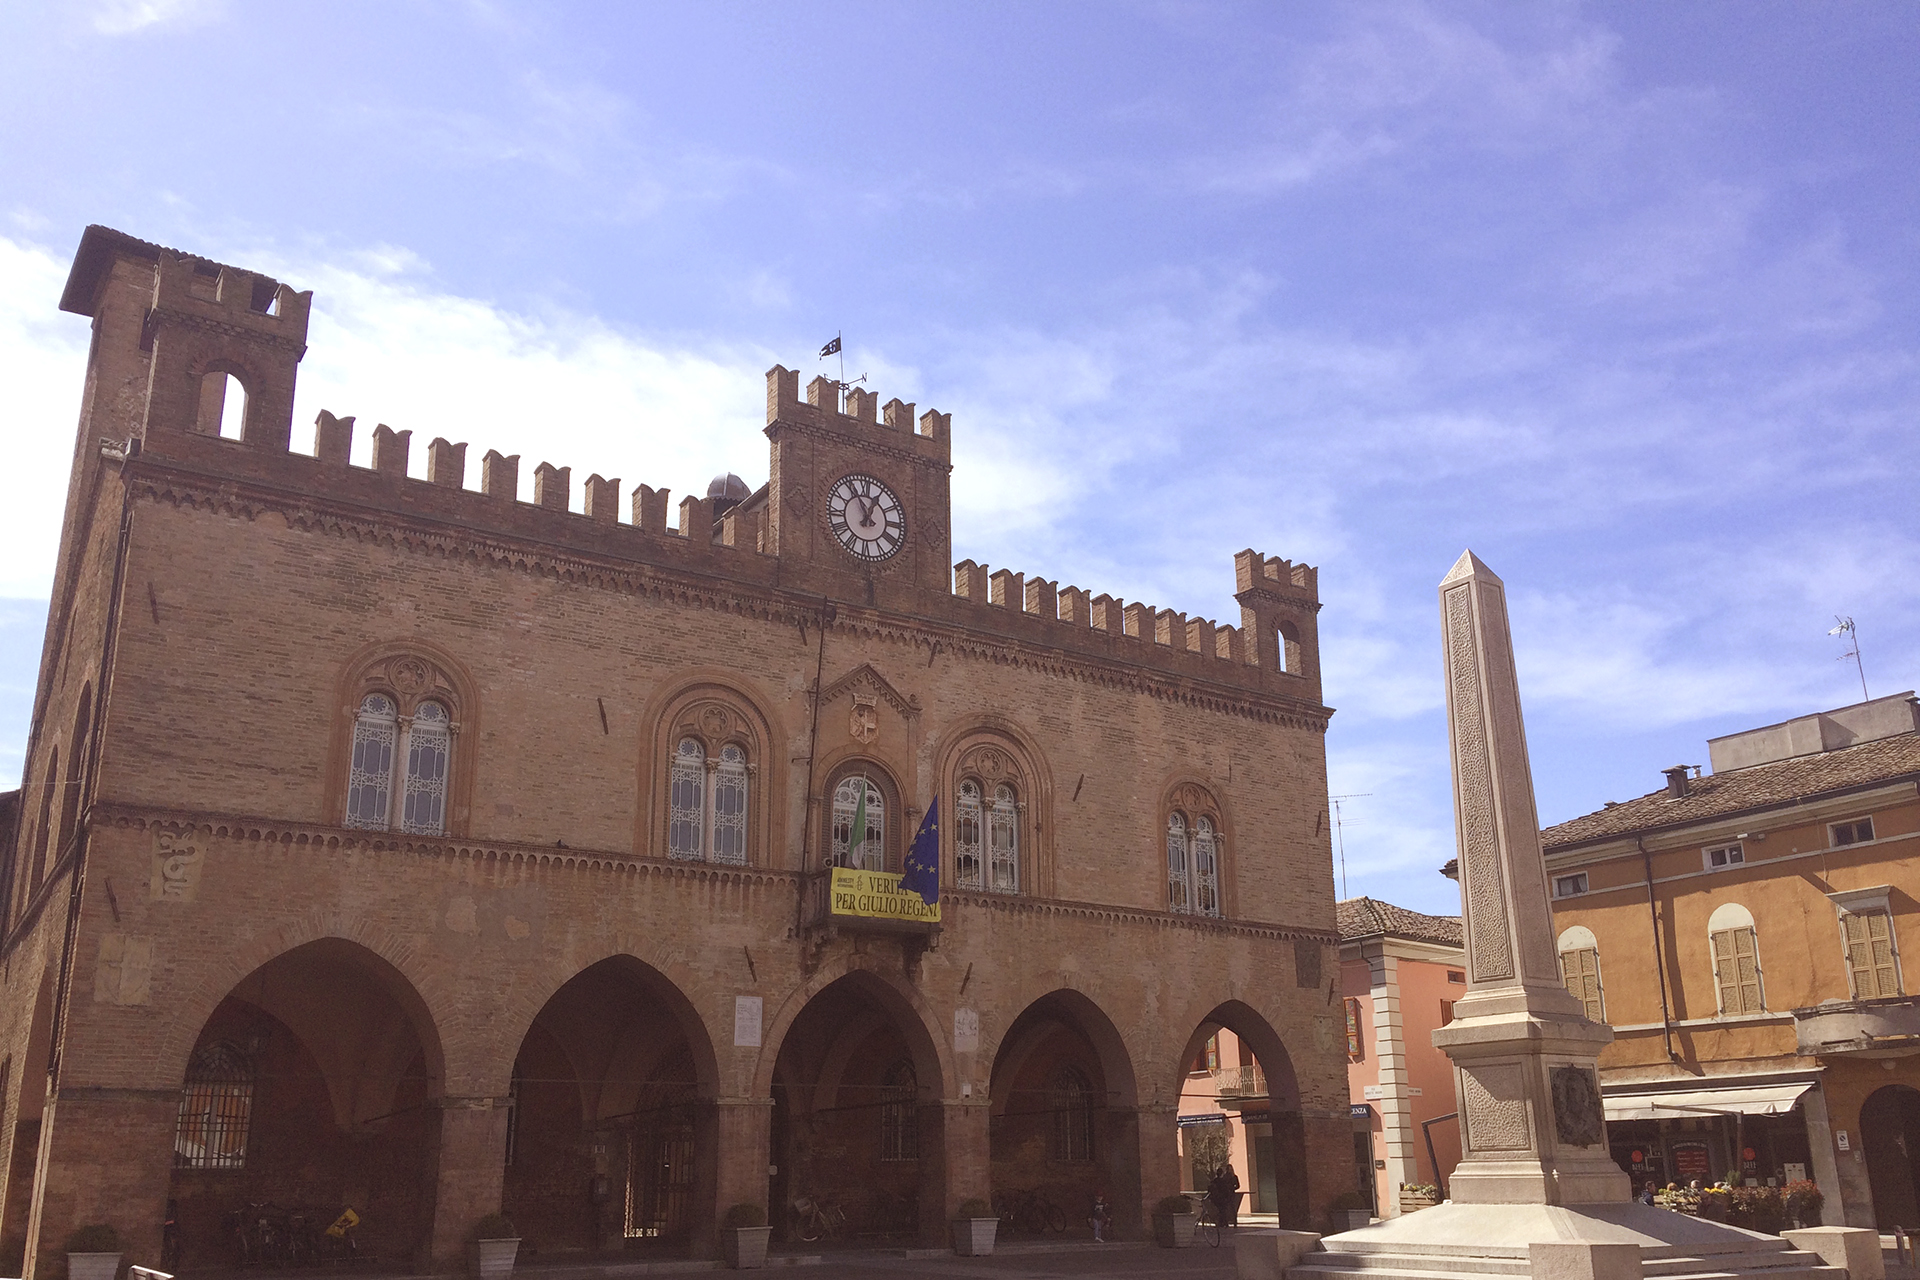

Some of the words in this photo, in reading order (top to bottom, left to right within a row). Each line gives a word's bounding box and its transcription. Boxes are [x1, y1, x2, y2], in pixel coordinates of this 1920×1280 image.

[835, 893, 856, 910] PER
[858, 894, 898, 914] GIULIO
[1351, 1107, 1367, 1115] ENZA
